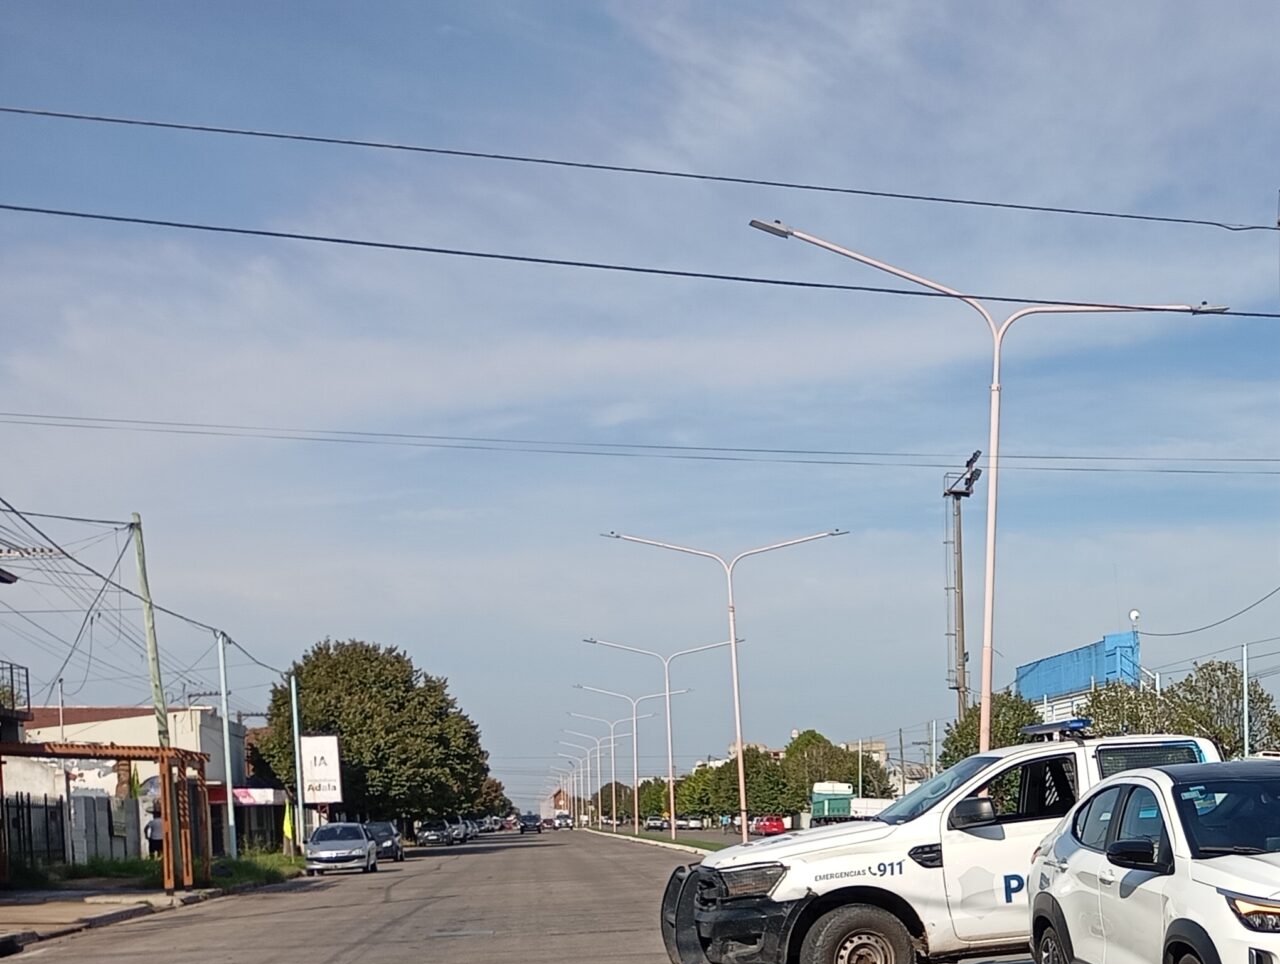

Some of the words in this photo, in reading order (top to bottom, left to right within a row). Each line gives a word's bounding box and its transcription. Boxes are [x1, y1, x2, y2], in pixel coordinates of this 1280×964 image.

[814, 869, 867, 882] EMERGENCIAS
[877, 859, 905, 877] 911
[1003, 874, 1029, 904] P
